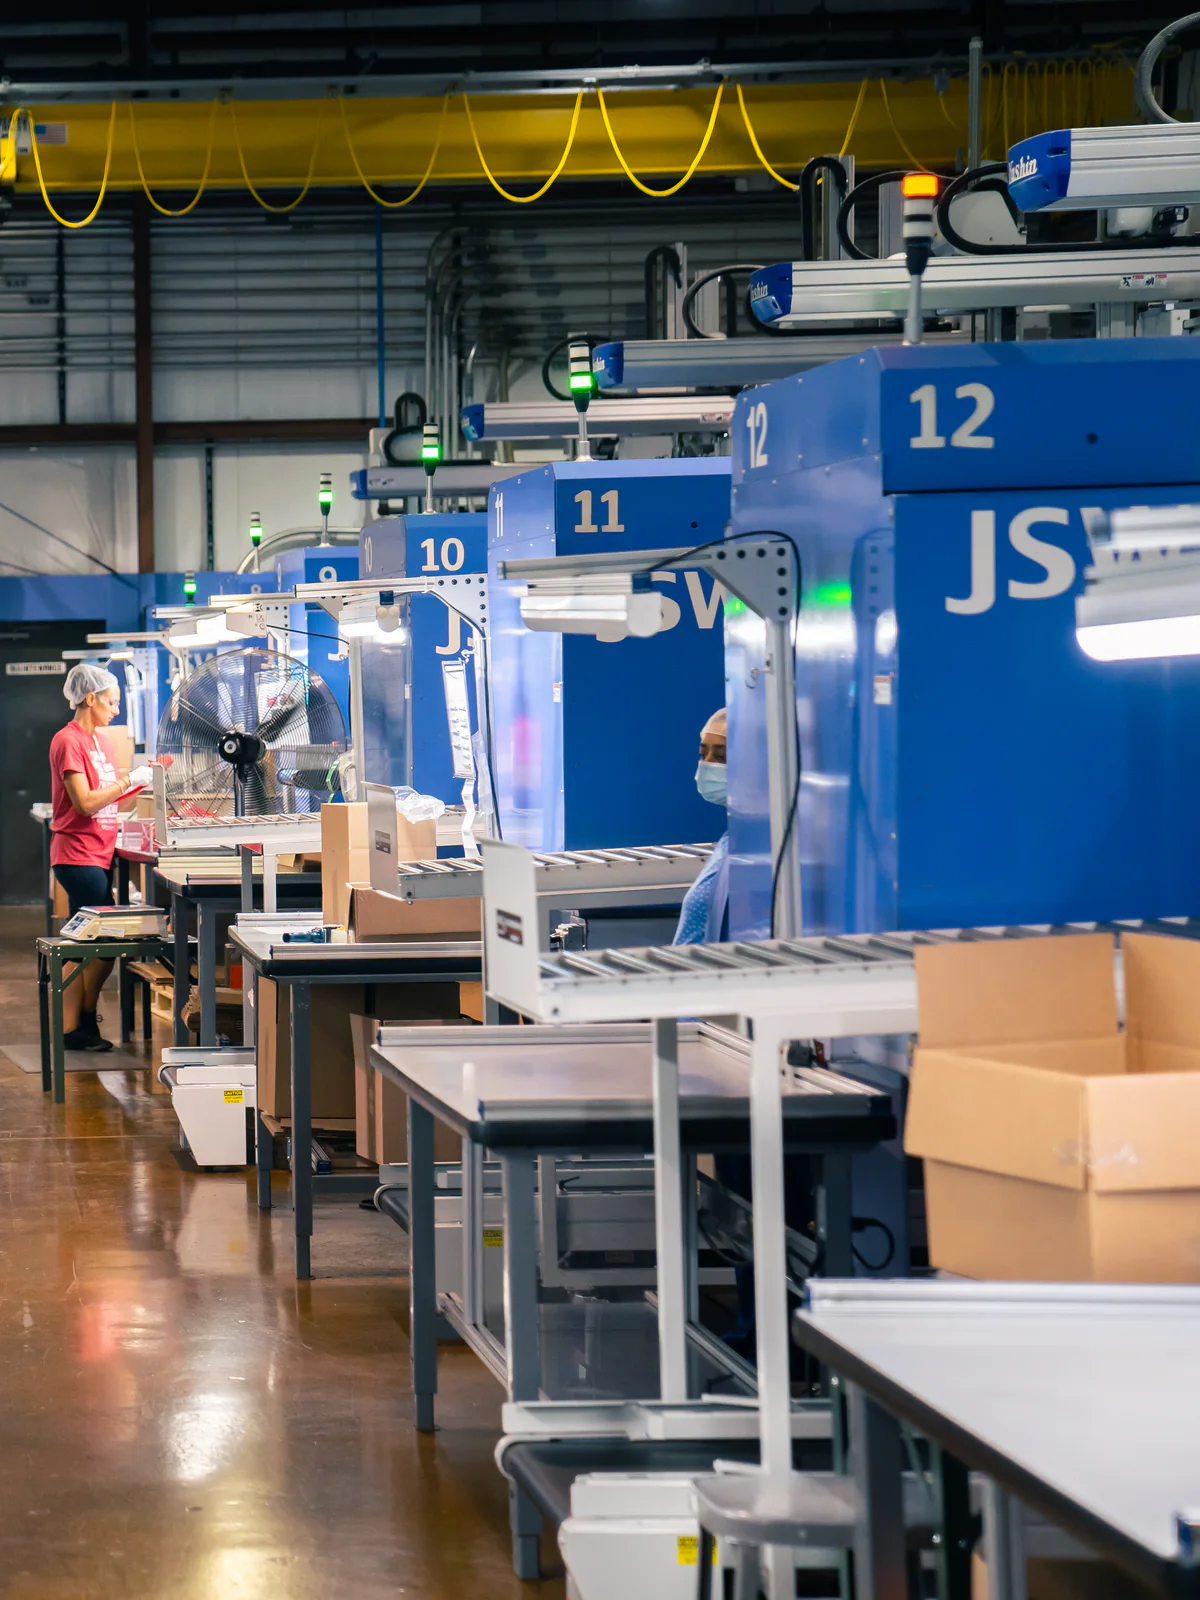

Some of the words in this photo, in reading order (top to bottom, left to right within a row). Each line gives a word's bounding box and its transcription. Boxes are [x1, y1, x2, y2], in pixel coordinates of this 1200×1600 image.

[747, 402, 768, 468] 12
[910, 383, 995, 449] 12
[495, 493, 503, 537] 11
[574, 490, 625, 533] 11
[364, 536, 373, 573] 10
[421, 537, 465, 572] 10
[945, 506, 1102, 615] JS
